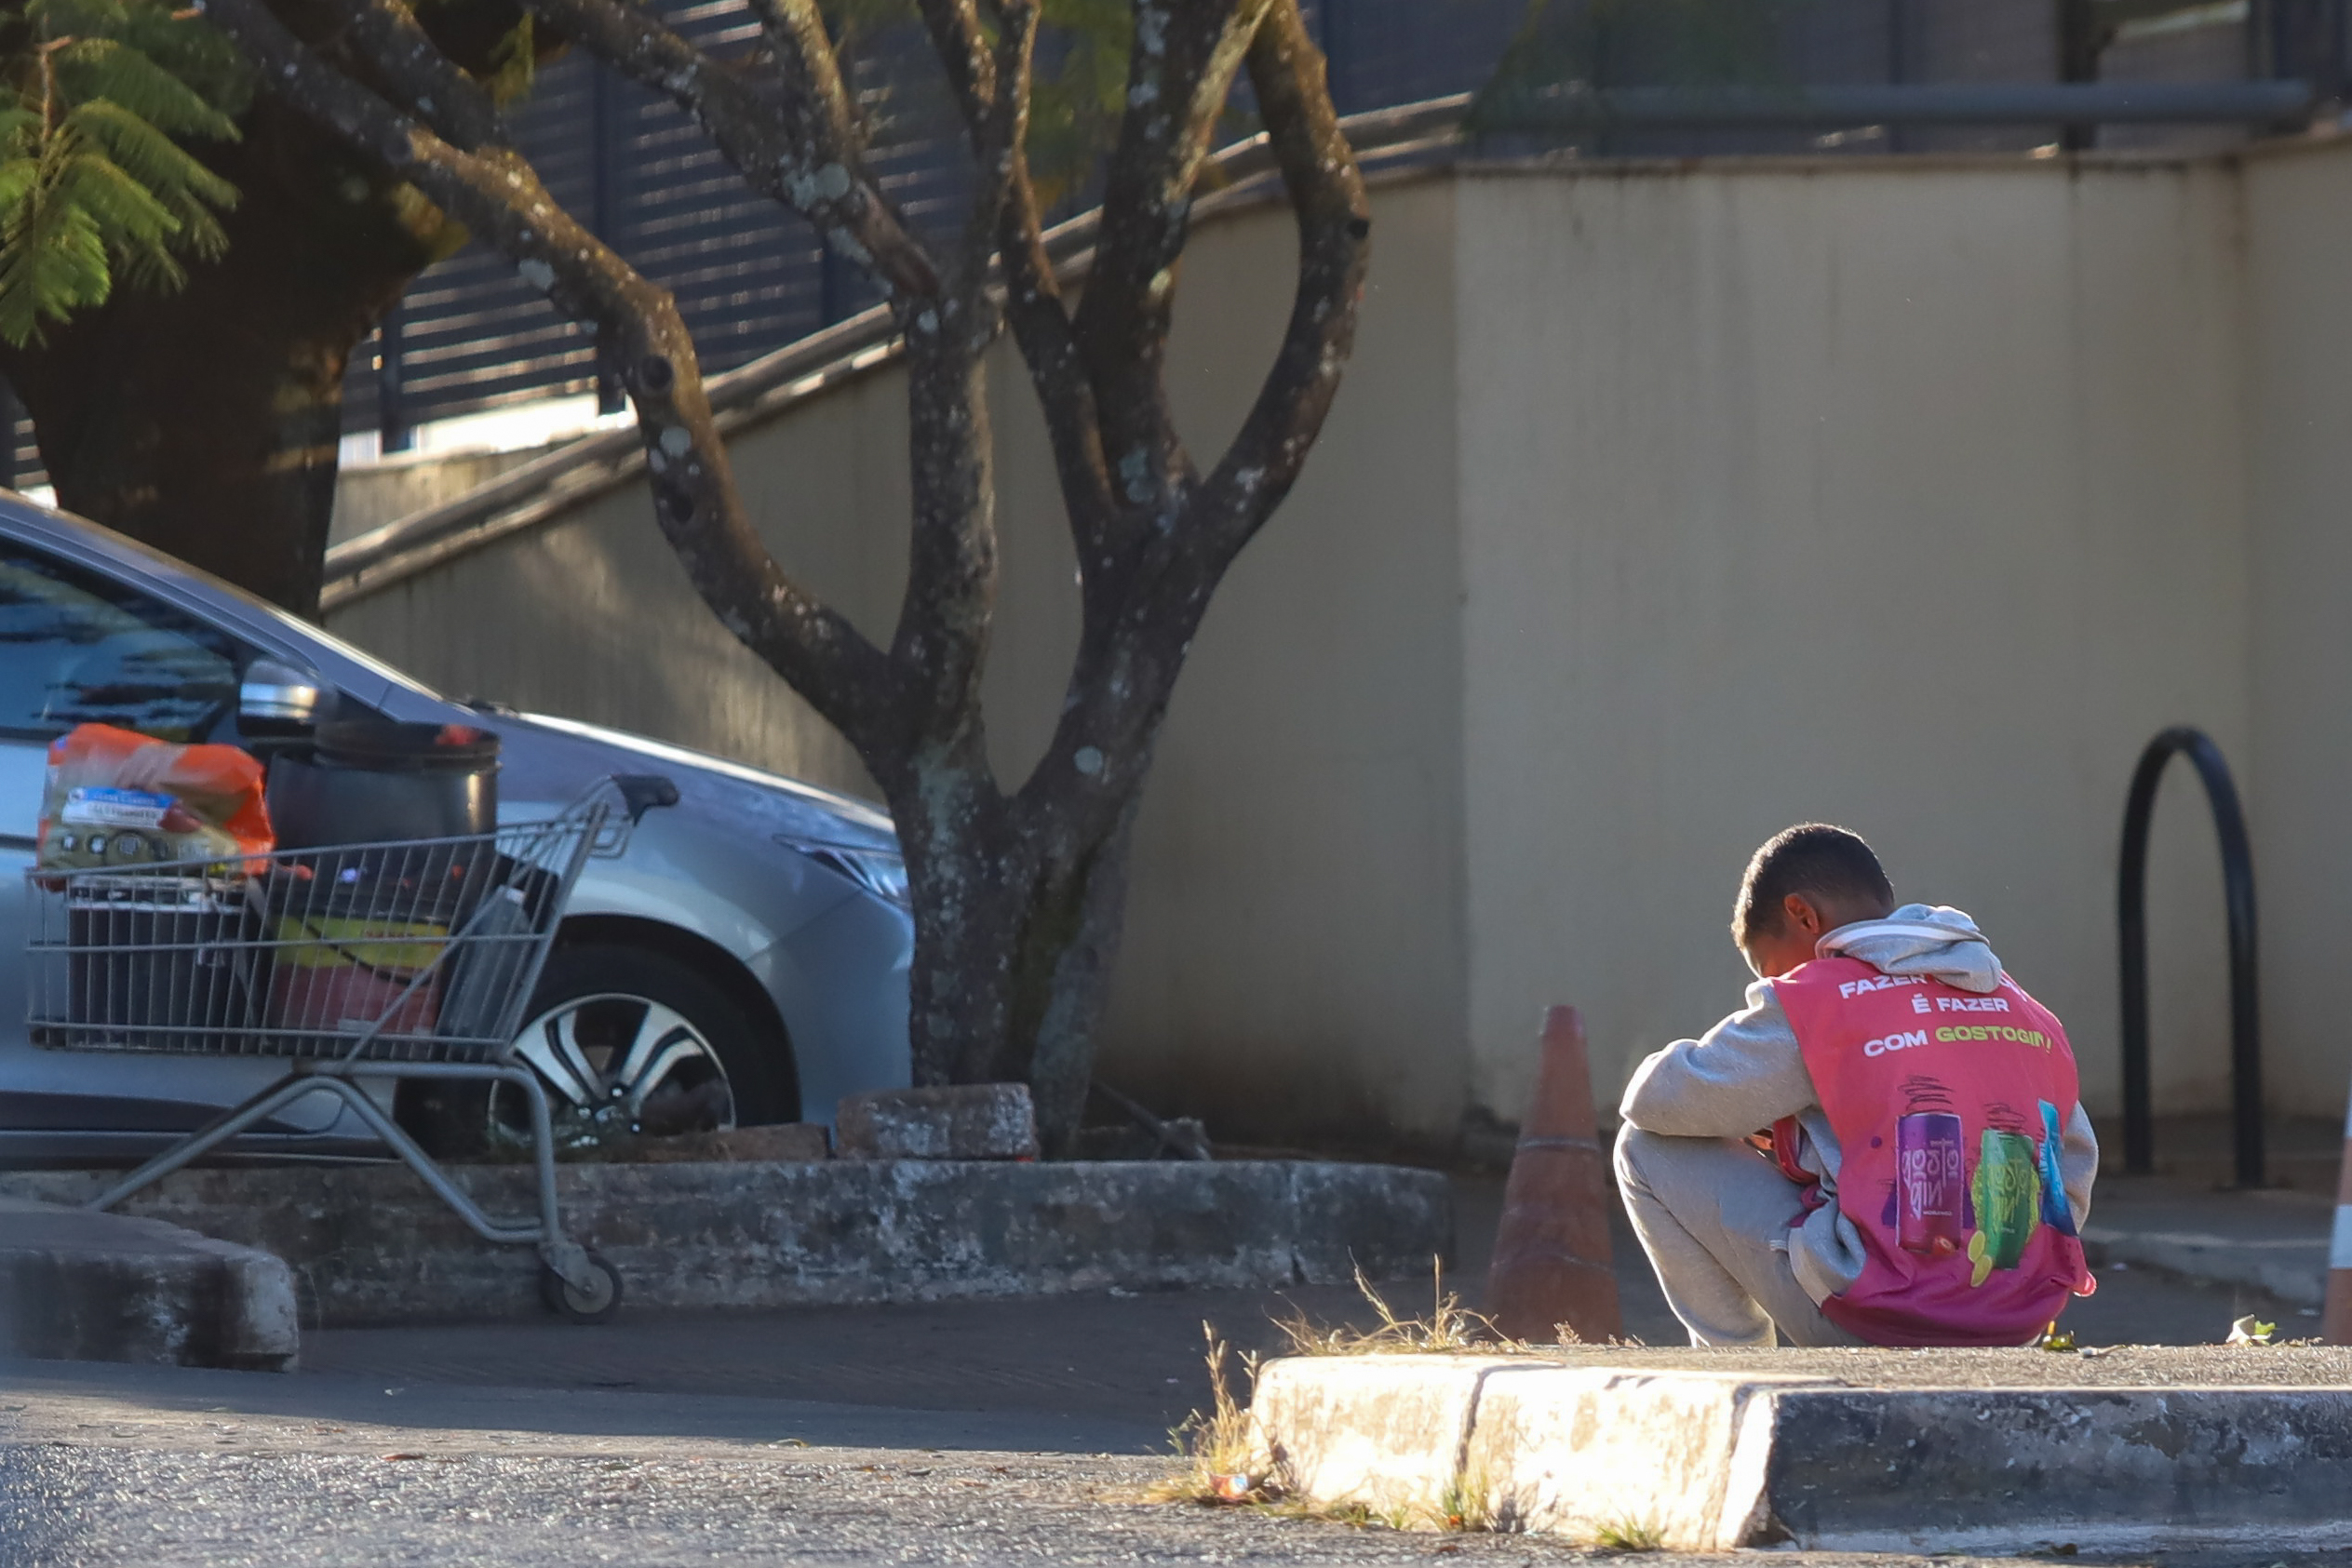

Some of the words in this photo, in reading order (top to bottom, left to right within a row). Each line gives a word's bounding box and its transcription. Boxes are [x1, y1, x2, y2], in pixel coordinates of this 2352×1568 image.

[1838, 974, 1928, 998] FAZER
[1912, 993, 1932, 1014] É
[1937, 998, 2009, 1012] FAZER
[1863, 1029, 1929, 1057] COM
